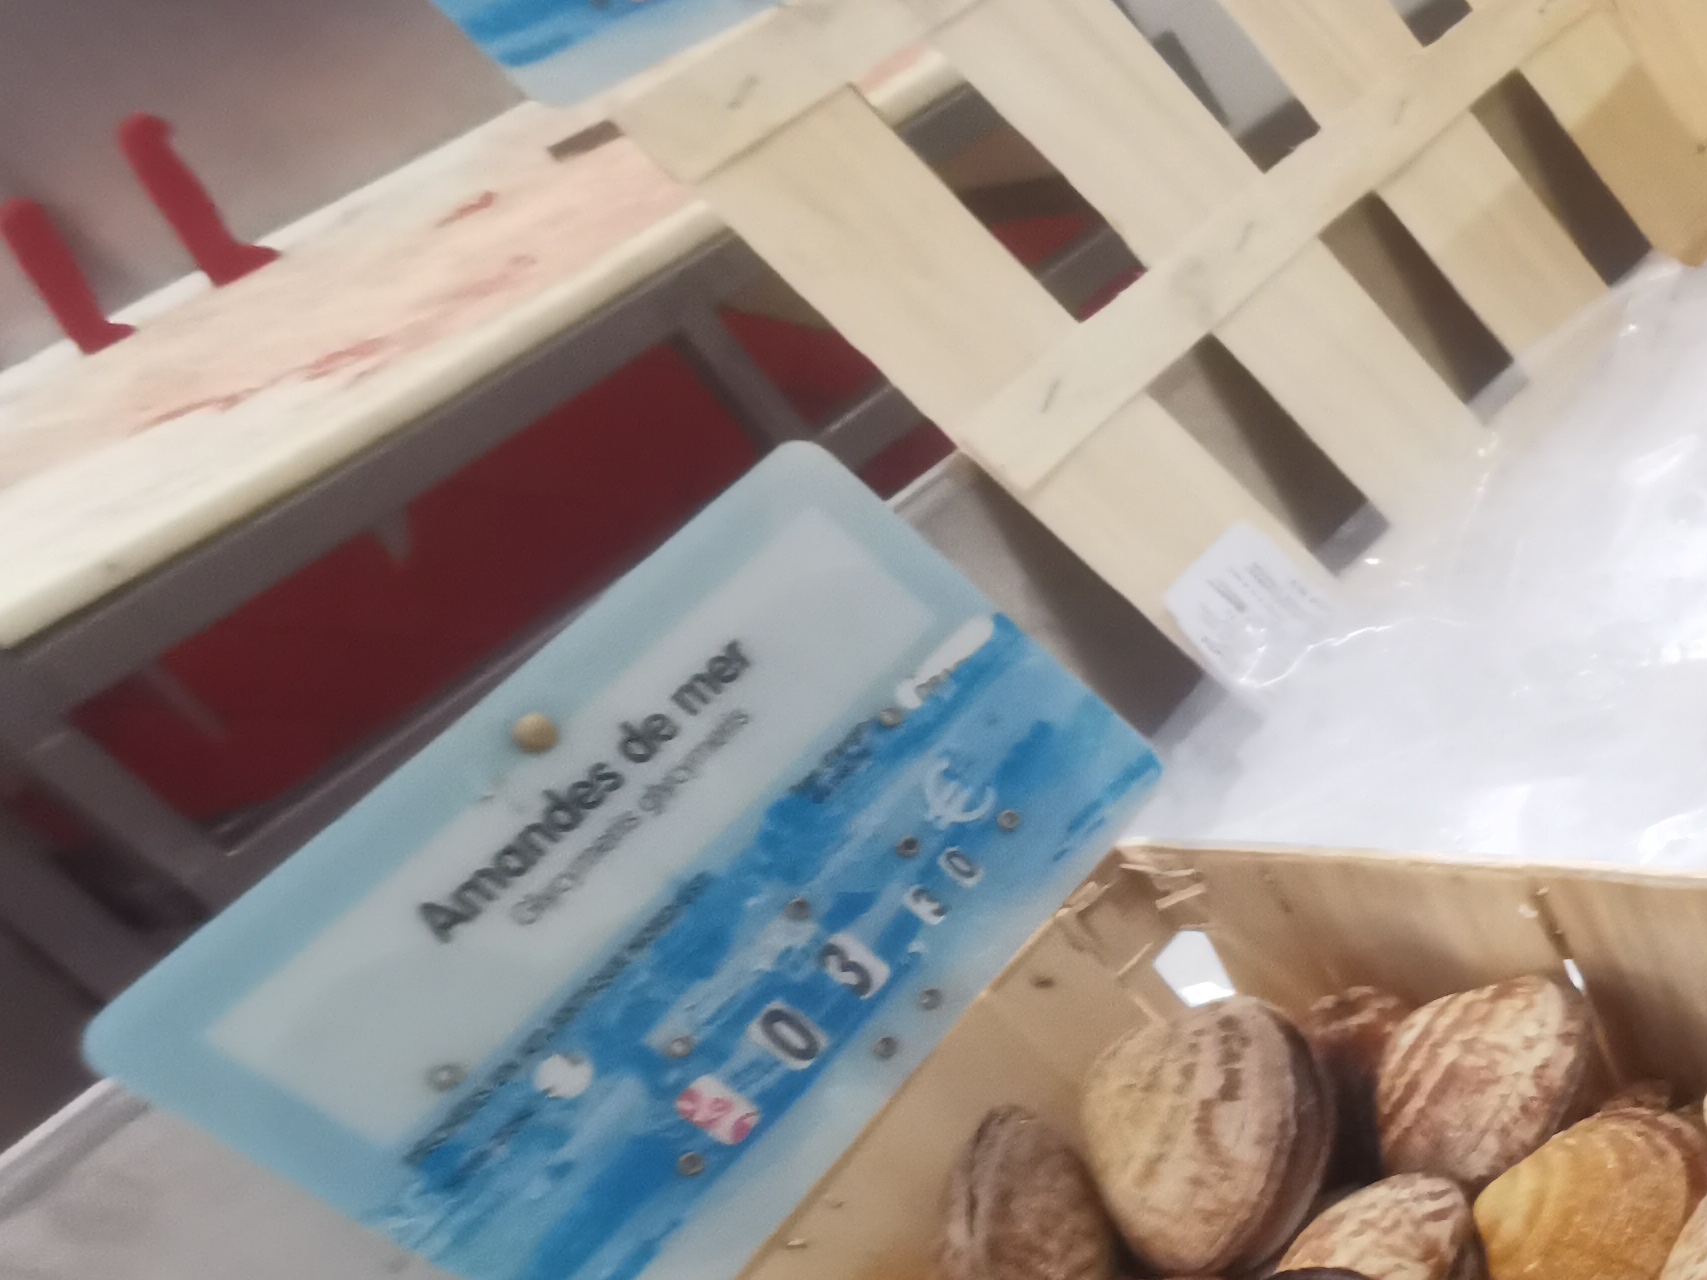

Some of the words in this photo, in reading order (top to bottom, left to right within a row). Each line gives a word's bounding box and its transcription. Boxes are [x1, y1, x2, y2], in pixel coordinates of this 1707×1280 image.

[418, 761, 625, 943] Amandes
[617, 712, 681, 763] de
[669, 639, 752, 717] mer
